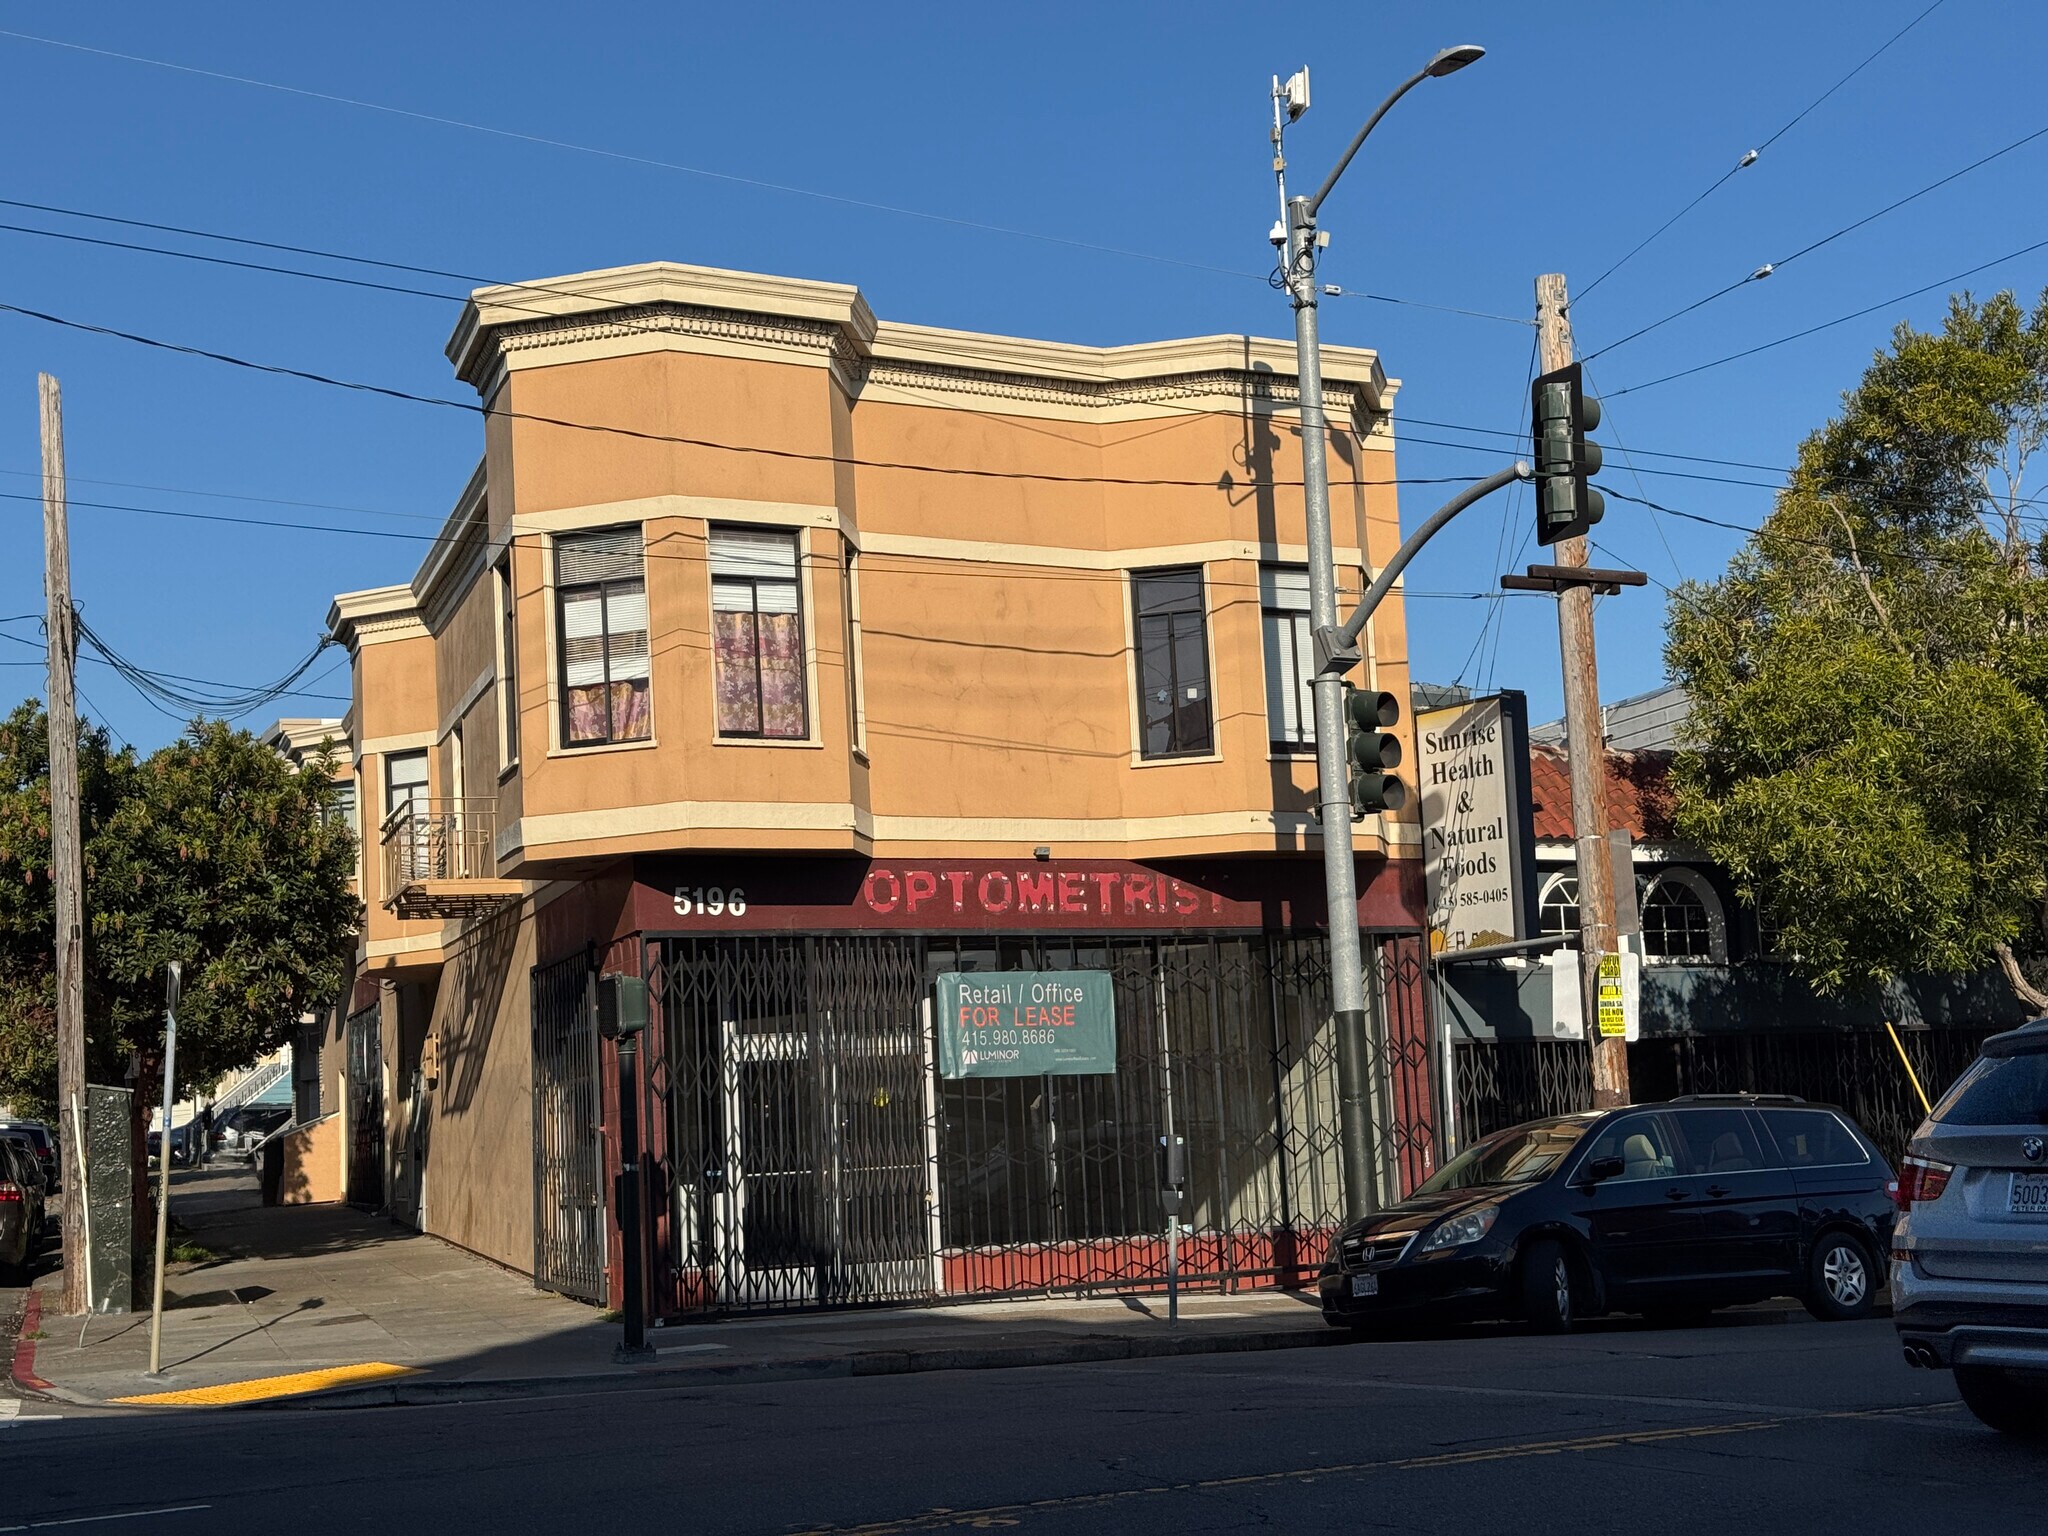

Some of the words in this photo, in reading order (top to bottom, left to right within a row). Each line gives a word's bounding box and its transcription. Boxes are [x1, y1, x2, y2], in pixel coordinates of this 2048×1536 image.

[1425, 724, 1496, 755] Sunrise
[1431, 753, 1494, 786] Health
[1457, 790, 1474, 814] &
[1430, 817, 1504, 850] Natural
[1442, 851, 1497, 879] Foods
[673, 886, 747, 917] 5196
[1460, 887, 1508, 907] 585-0405
[959, 983, 1011, 1005] Retail
[1019, 984, 1024, 1003] /
[1031, 983, 1083, 1003] Office
[960, 1006, 1000, 1028] FOR
[1014, 1005, 1076, 1027] LEASE
[962, 1029, 1055, 1046] 415.980.8686
[980, 1049, 1020, 1061] LUMINOR
